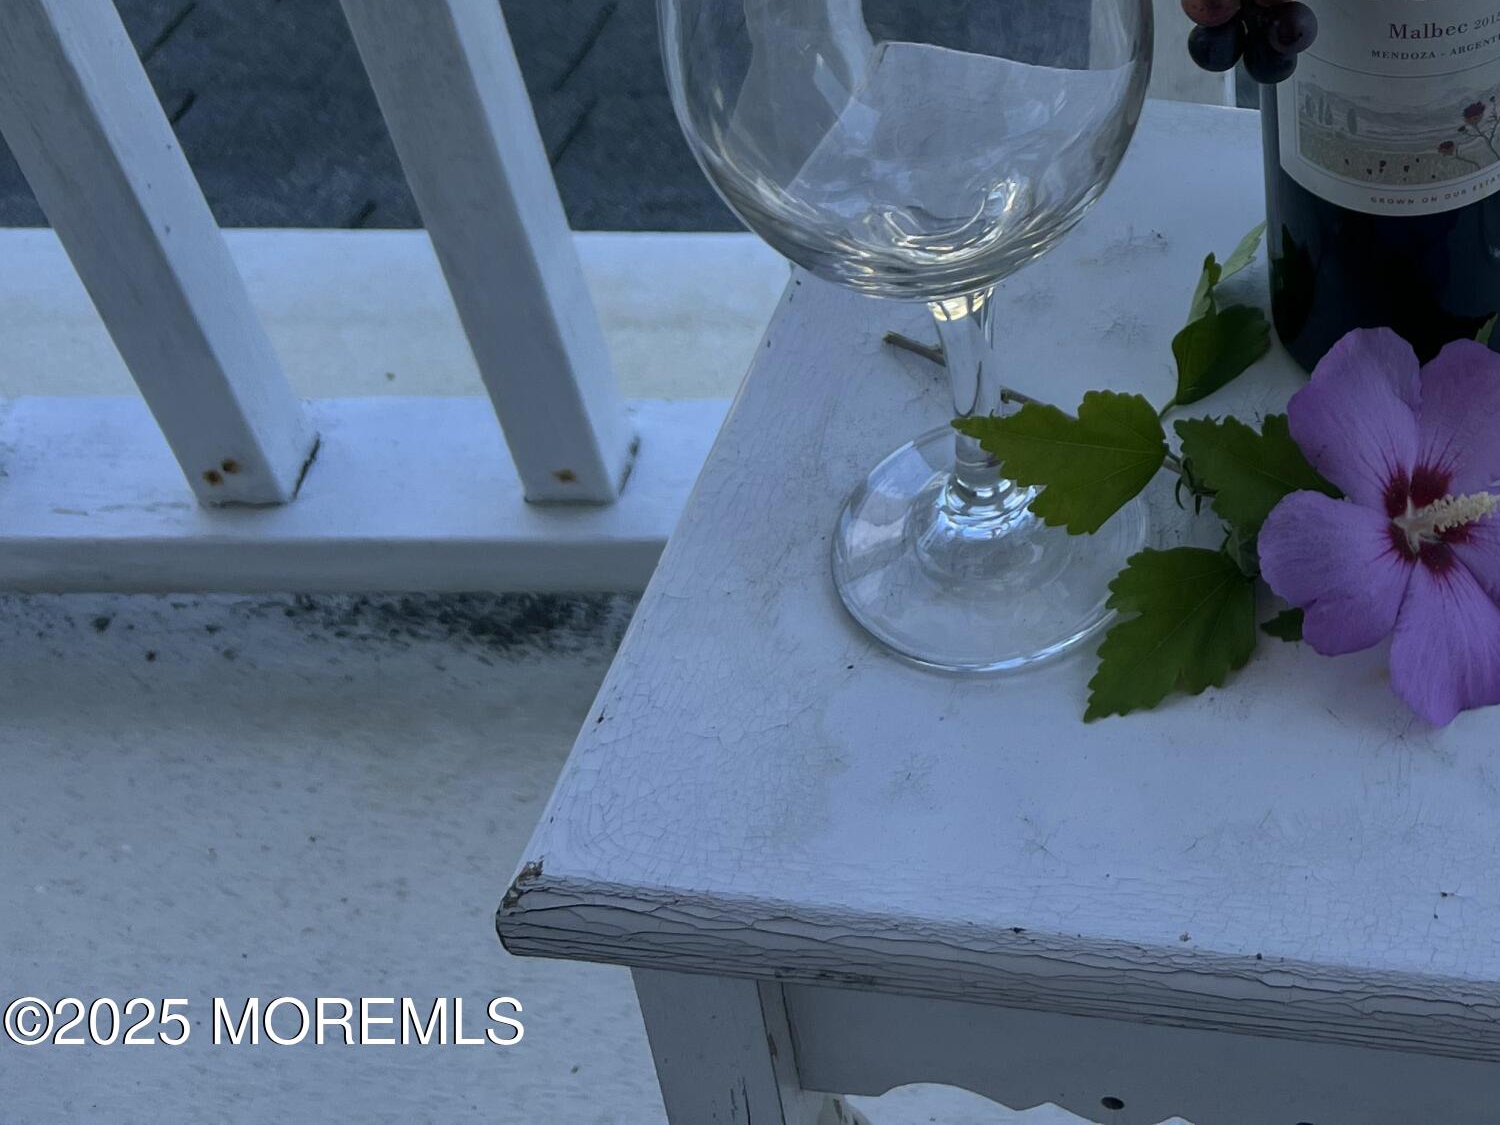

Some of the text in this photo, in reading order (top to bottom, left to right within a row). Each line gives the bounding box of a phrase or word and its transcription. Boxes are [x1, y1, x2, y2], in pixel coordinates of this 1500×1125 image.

[1389, 21, 1469, 40] Malbec
[1371, 49, 1437, 61] MENDOZA
[1370, 196, 1415, 205] GROWN
[1443, 189, 1467, 200] OUR
